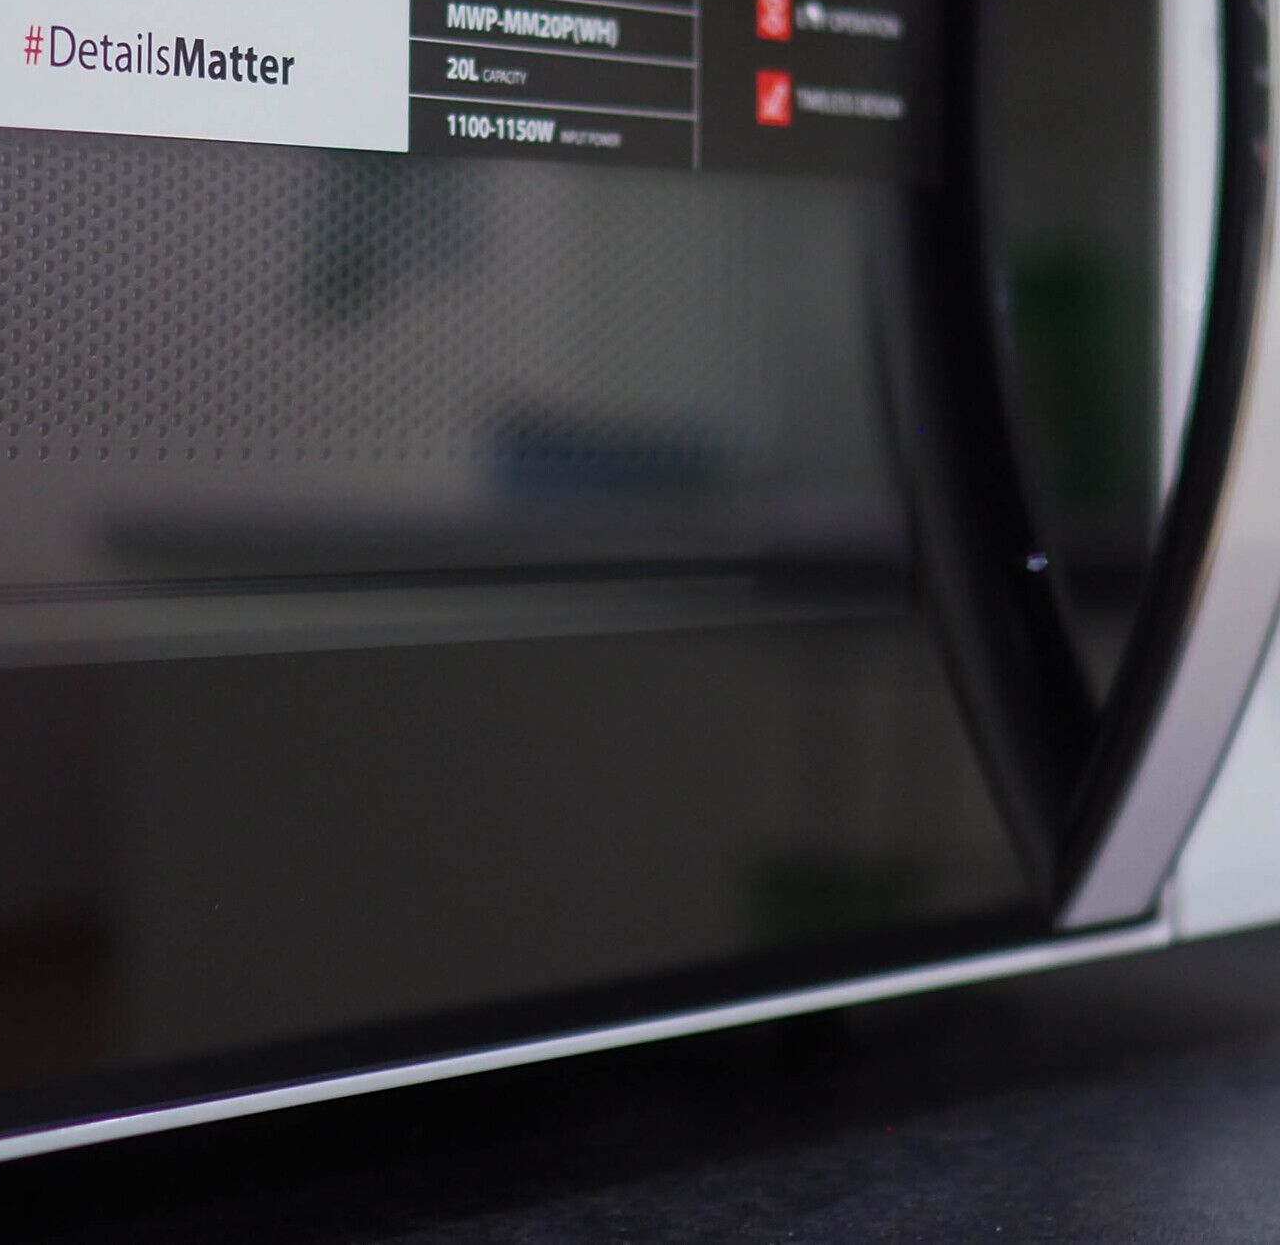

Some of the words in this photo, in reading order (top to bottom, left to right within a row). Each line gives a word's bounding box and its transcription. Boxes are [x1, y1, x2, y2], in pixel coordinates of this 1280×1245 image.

[446, 2, 619, 49] MWP-MM20P(WH)
[24, 24, 296, 86] #DetailsMatter
[446, 56, 480, 82] 20L
[482, 68, 527, 85] CAPACITY
[446, 113, 556, 144] 1100-1150W
